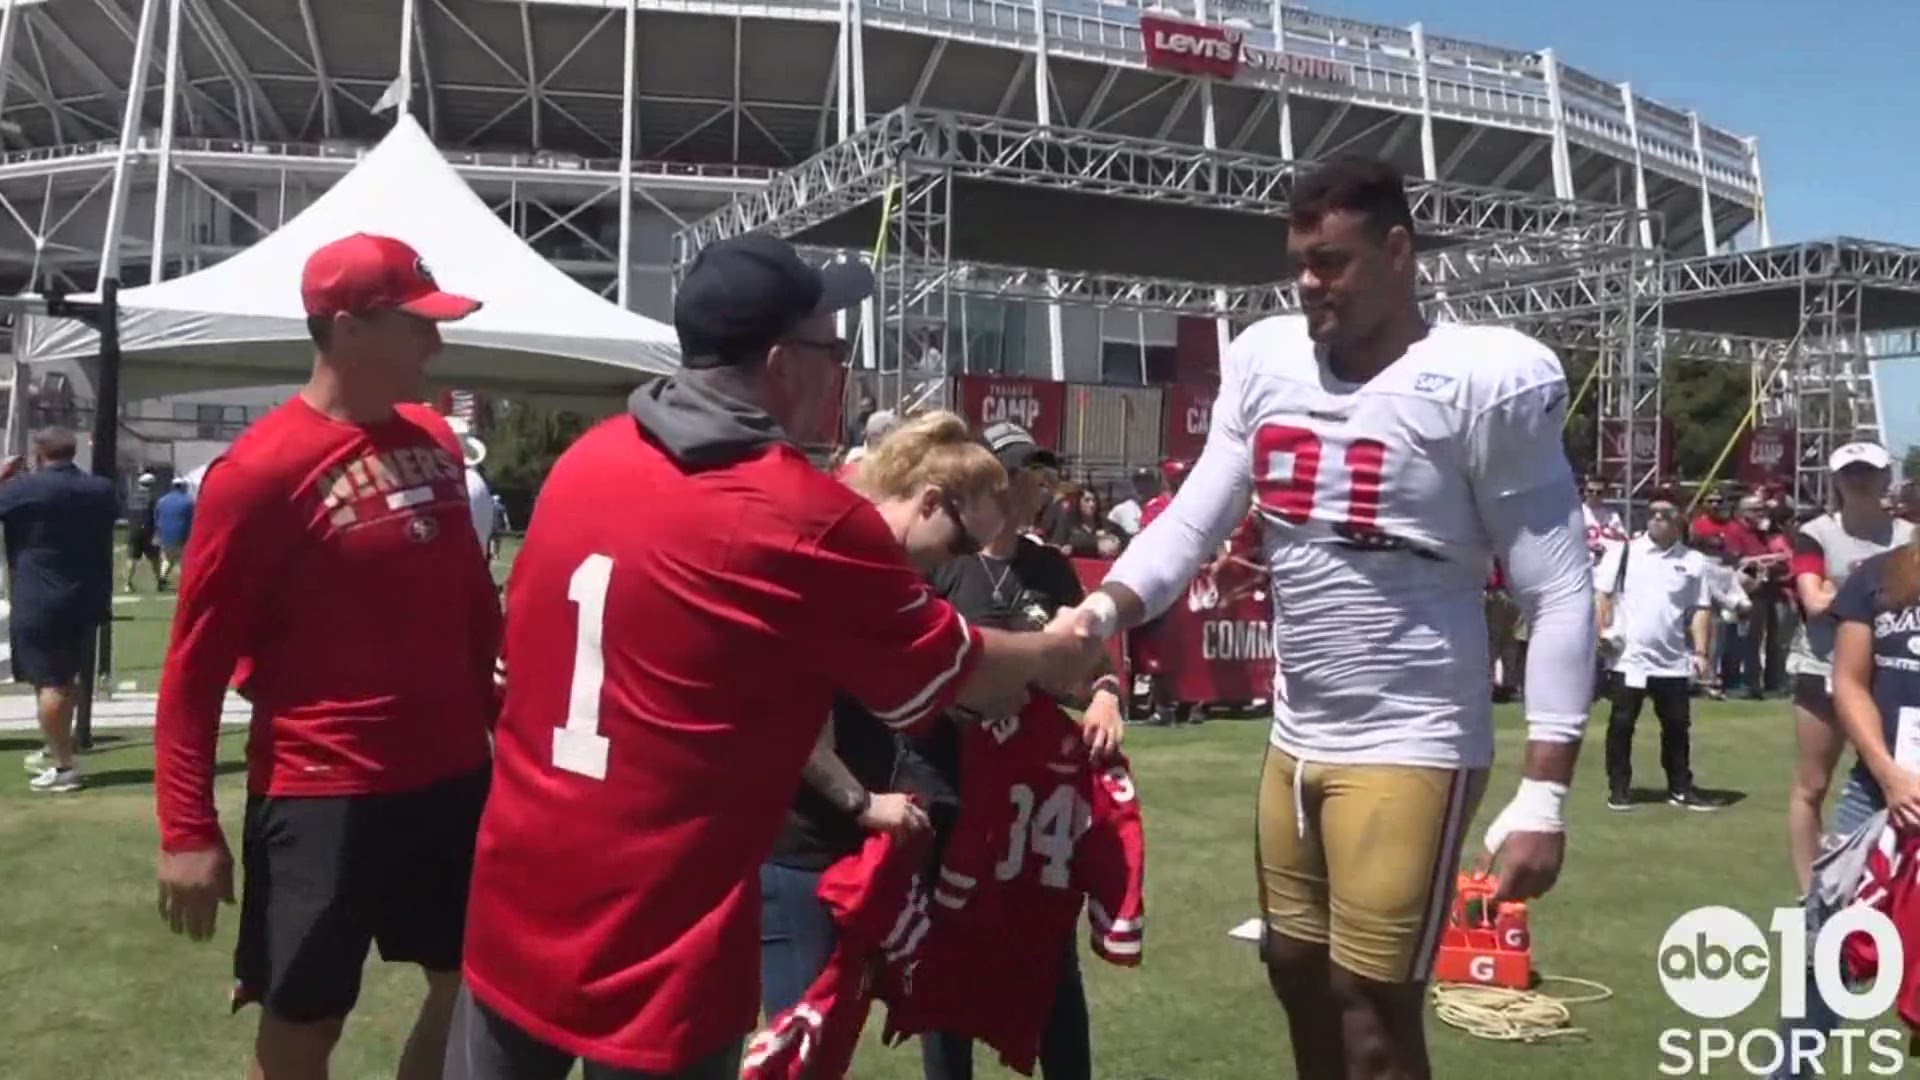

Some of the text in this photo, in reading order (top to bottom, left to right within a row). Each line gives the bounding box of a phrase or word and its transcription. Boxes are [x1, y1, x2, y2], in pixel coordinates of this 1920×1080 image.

[1245, 46, 1348, 82] STADIUM
[982, 396, 1040, 428] CAMP
[1186, 407, 1210, 434] CA
[551, 552, 615, 781] 1
[1504, 929, 1522, 946] G
[1468, 956, 1495, 982] G
